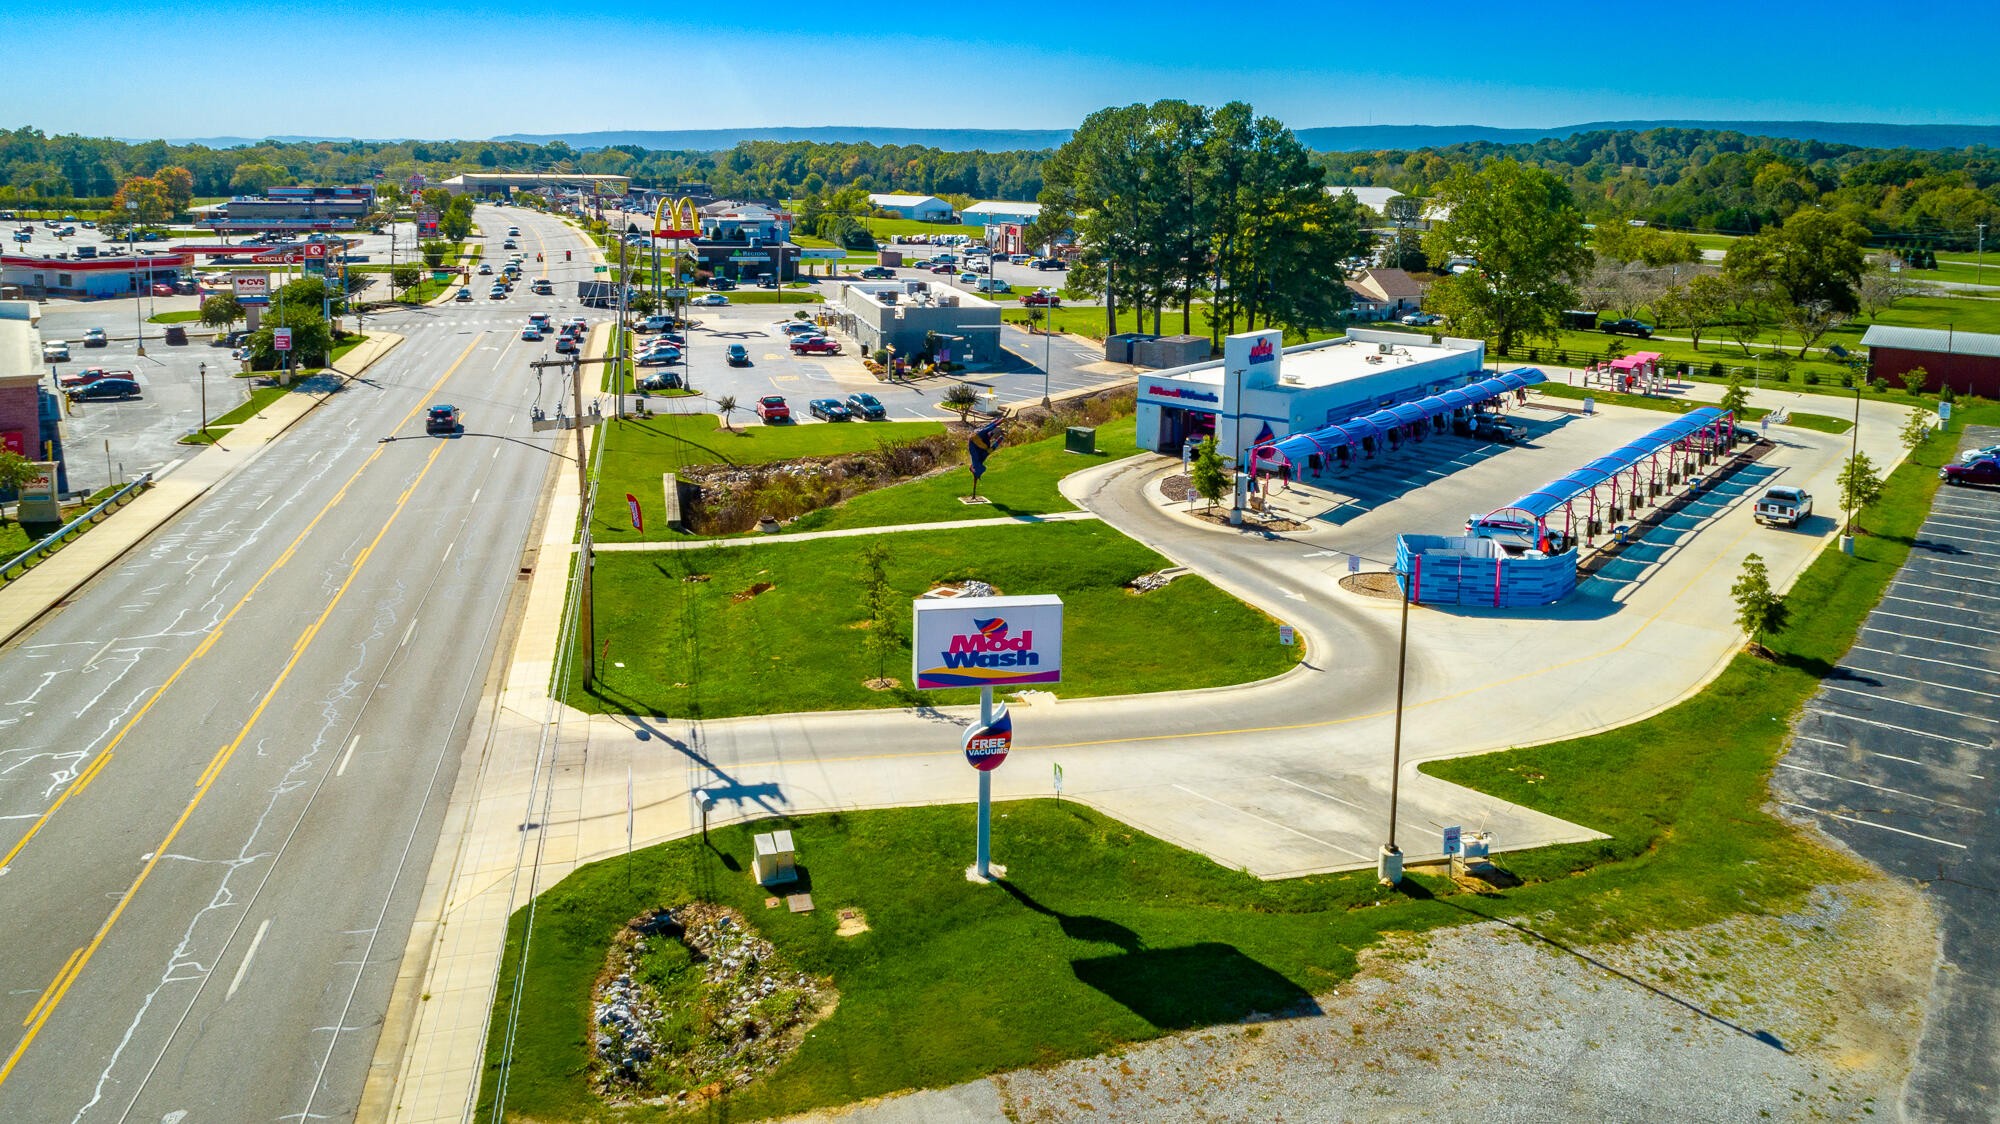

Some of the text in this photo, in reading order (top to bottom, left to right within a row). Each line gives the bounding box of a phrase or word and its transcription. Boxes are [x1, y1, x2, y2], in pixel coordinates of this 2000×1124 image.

[949, 630, 1032, 653] Mod
[941, 650, 1039, 669] Wash
[968, 747, 1009, 756] VACUUMS
[971, 737, 1006, 750] FREE
